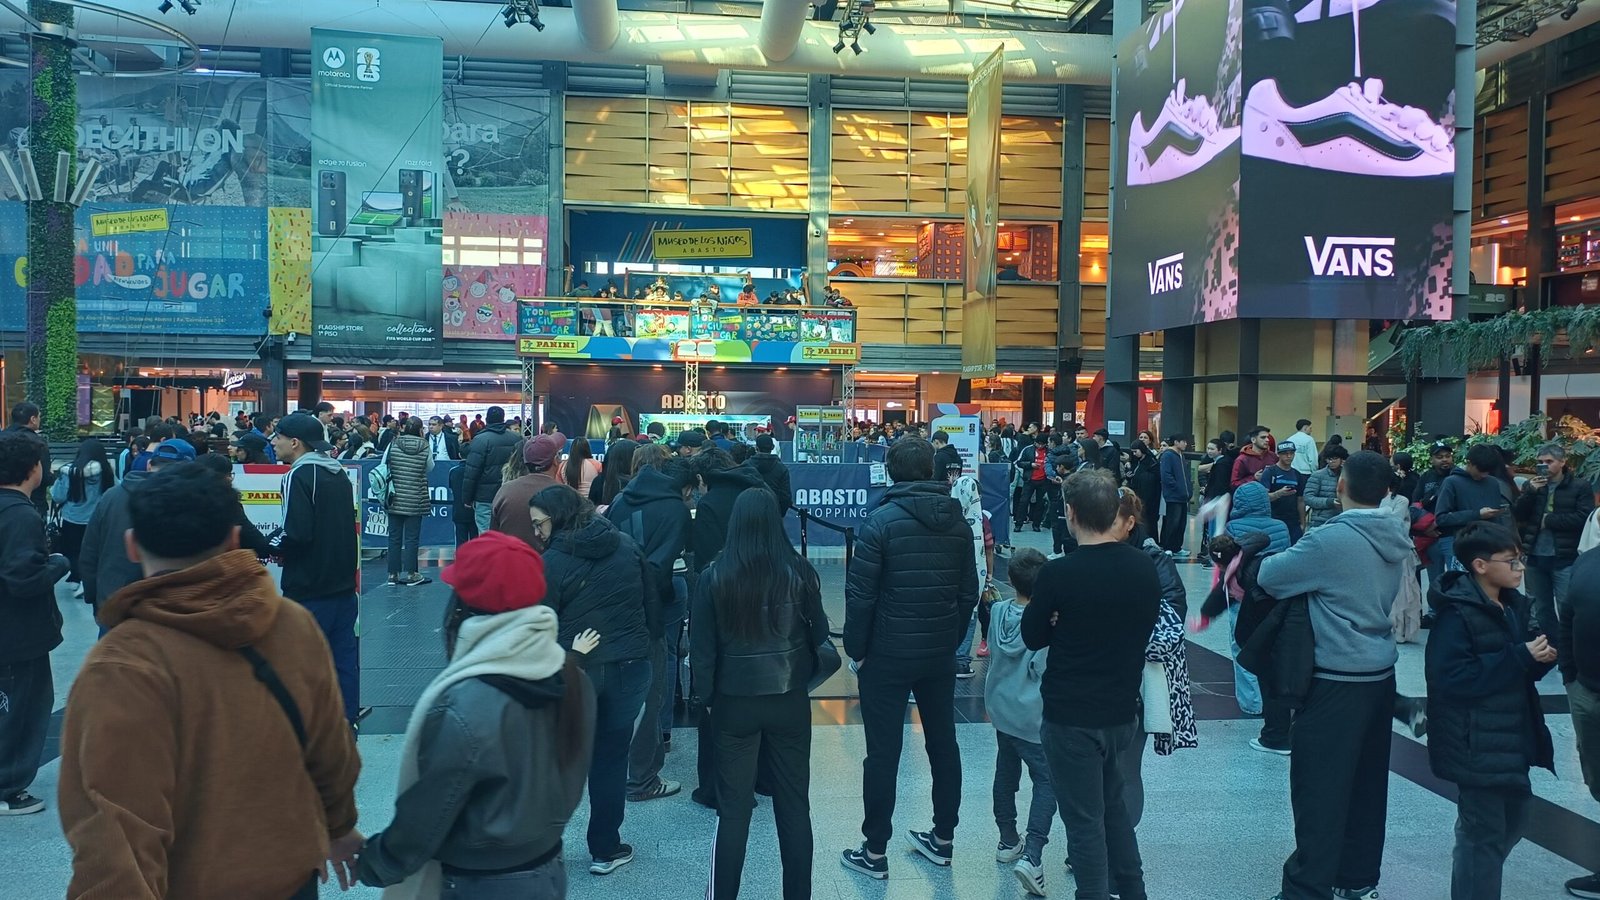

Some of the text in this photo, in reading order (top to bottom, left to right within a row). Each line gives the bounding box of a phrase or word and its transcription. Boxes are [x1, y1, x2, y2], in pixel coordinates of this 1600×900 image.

[318, 70, 350, 78] motorola
[658, 235, 747, 246] MUSEO DE LOS NIÑOS
[1304, 236, 1396, 276] VANS
[1148, 252, 1184, 294] VANS
[154, 268, 245, 299] JUGAR
[386, 322, 434, 335] collections
[662, 394, 726, 409] ABASTO
[796, 488, 868, 505] ABASTO
[796, 508, 868, 518] HOPPING
